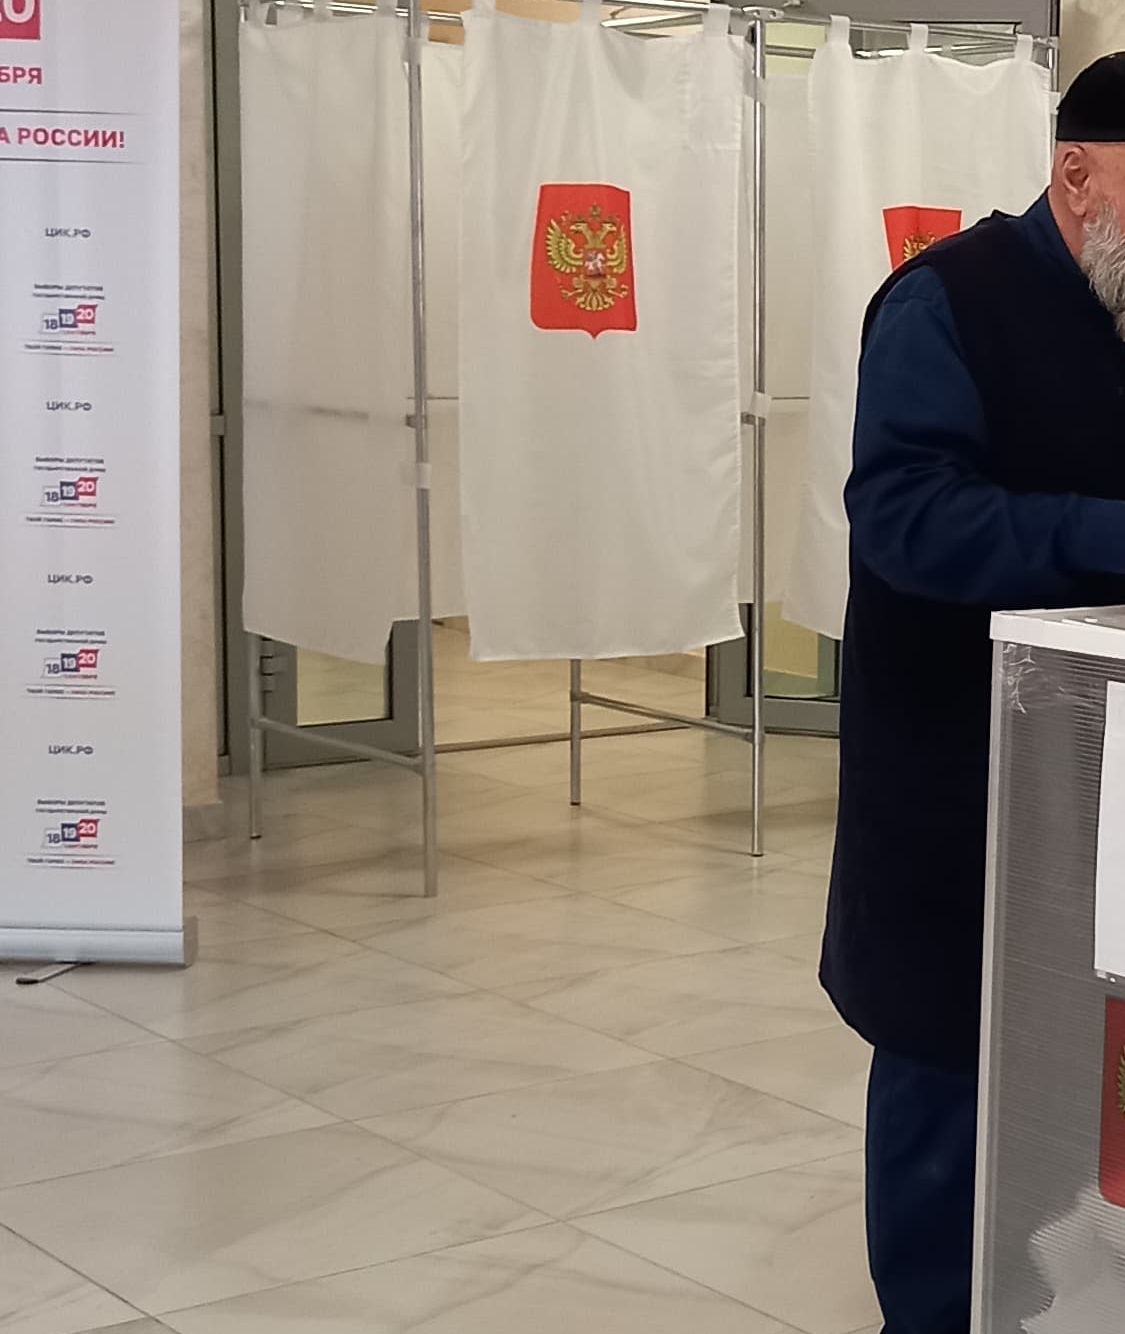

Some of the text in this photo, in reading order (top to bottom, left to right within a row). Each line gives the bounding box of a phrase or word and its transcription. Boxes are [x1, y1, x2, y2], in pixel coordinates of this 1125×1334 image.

[18, 128, 126, 149] РОССИИ!
[45, 227, 91, 239] ЦИК.РФ
[76, 308, 94, 320] 20
[46, 401, 92, 413] ЦИК.РФ
[77, 481, 95, 492] 20
[47, 574, 93, 585] ЦИК.РФ
[78, 653, 96, 664] 20
[48, 745, 94, 756] ЦИК.РФ
[79, 823, 96, 834] 20
